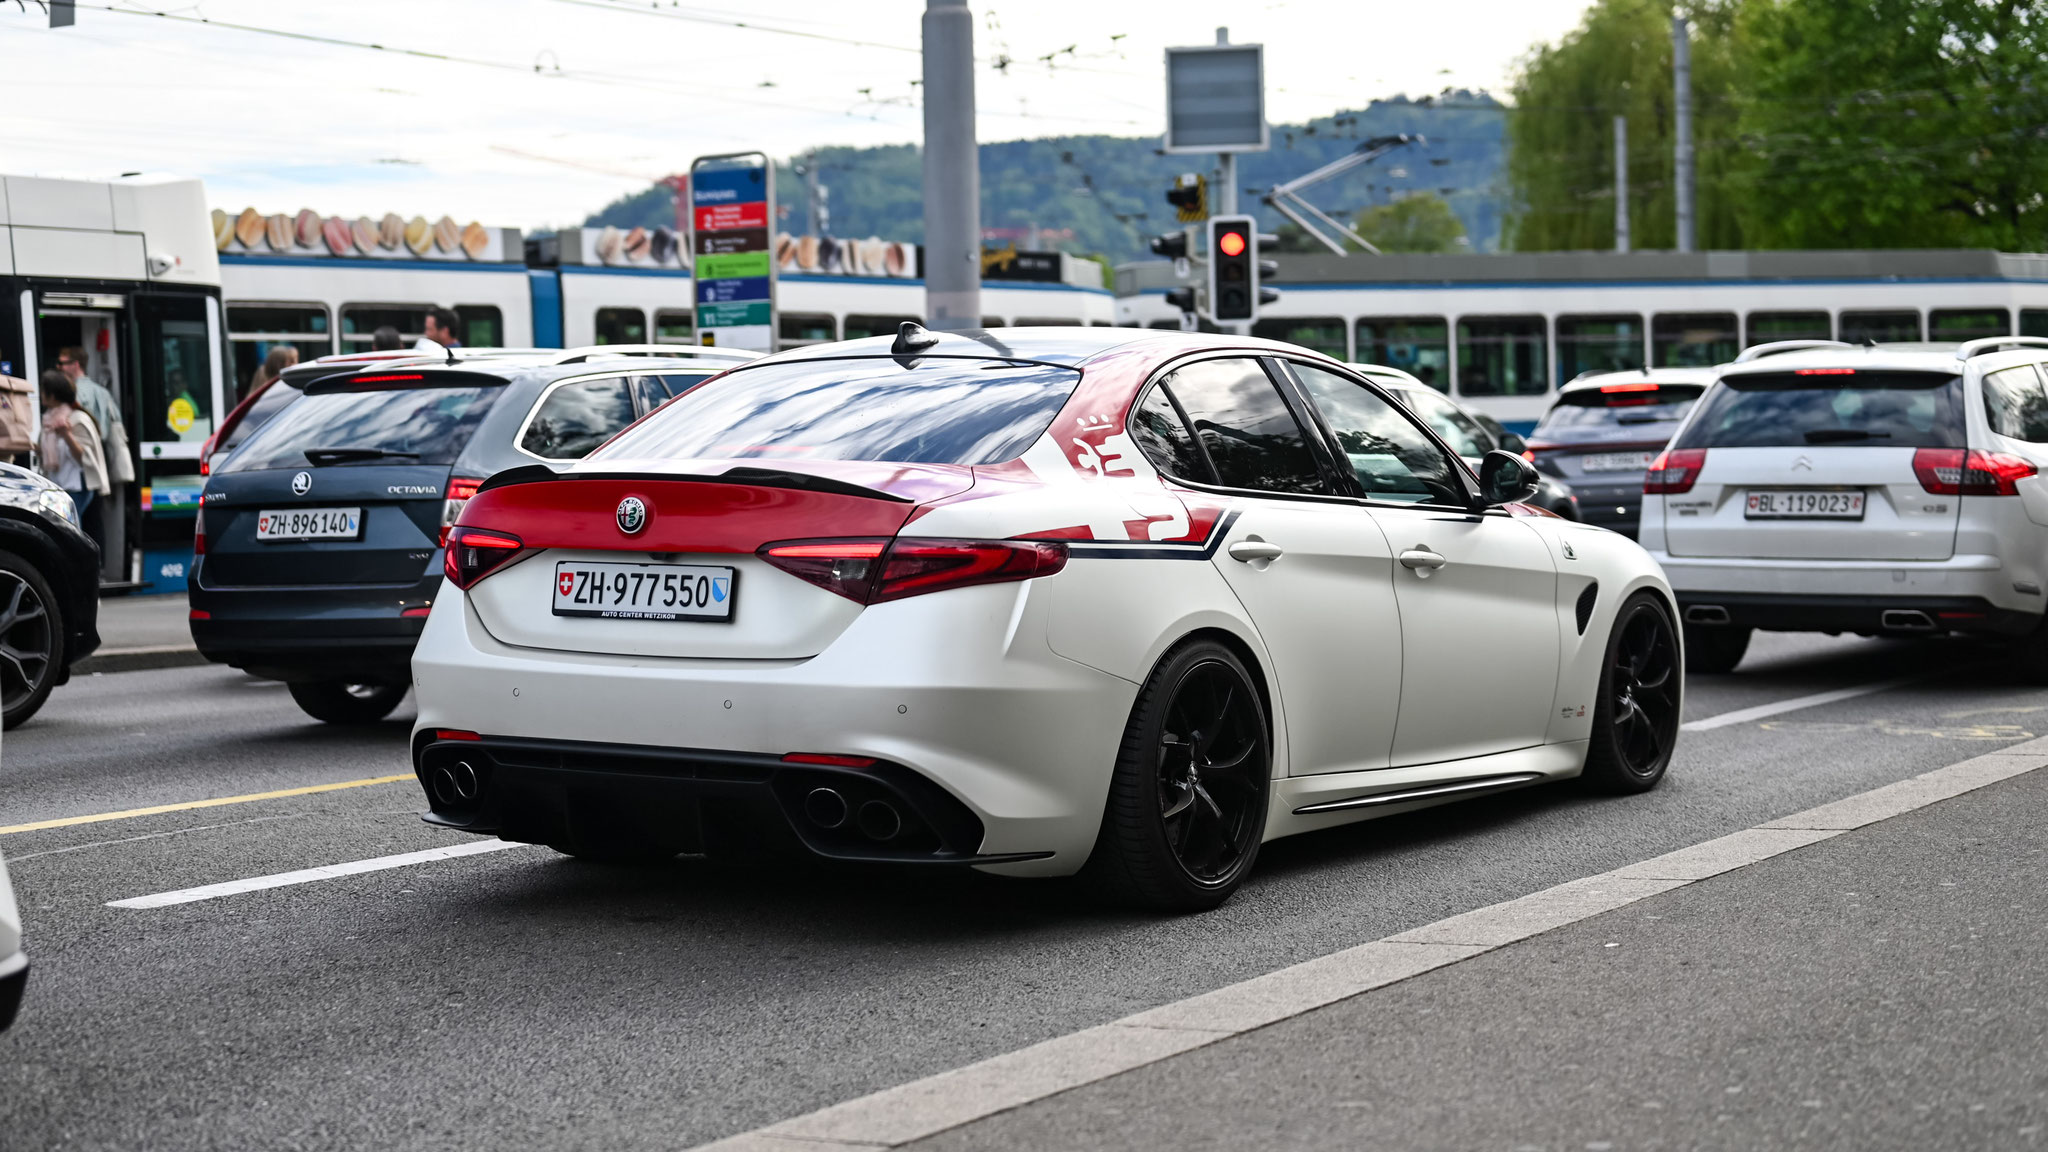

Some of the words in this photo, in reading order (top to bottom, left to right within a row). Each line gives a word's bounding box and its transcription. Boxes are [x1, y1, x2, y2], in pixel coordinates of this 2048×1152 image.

[387, 485, 438, 494] OCTAVIA
[618, 611, 643, 619] CENTER
[643, 612, 676, 620] WETZIKON
